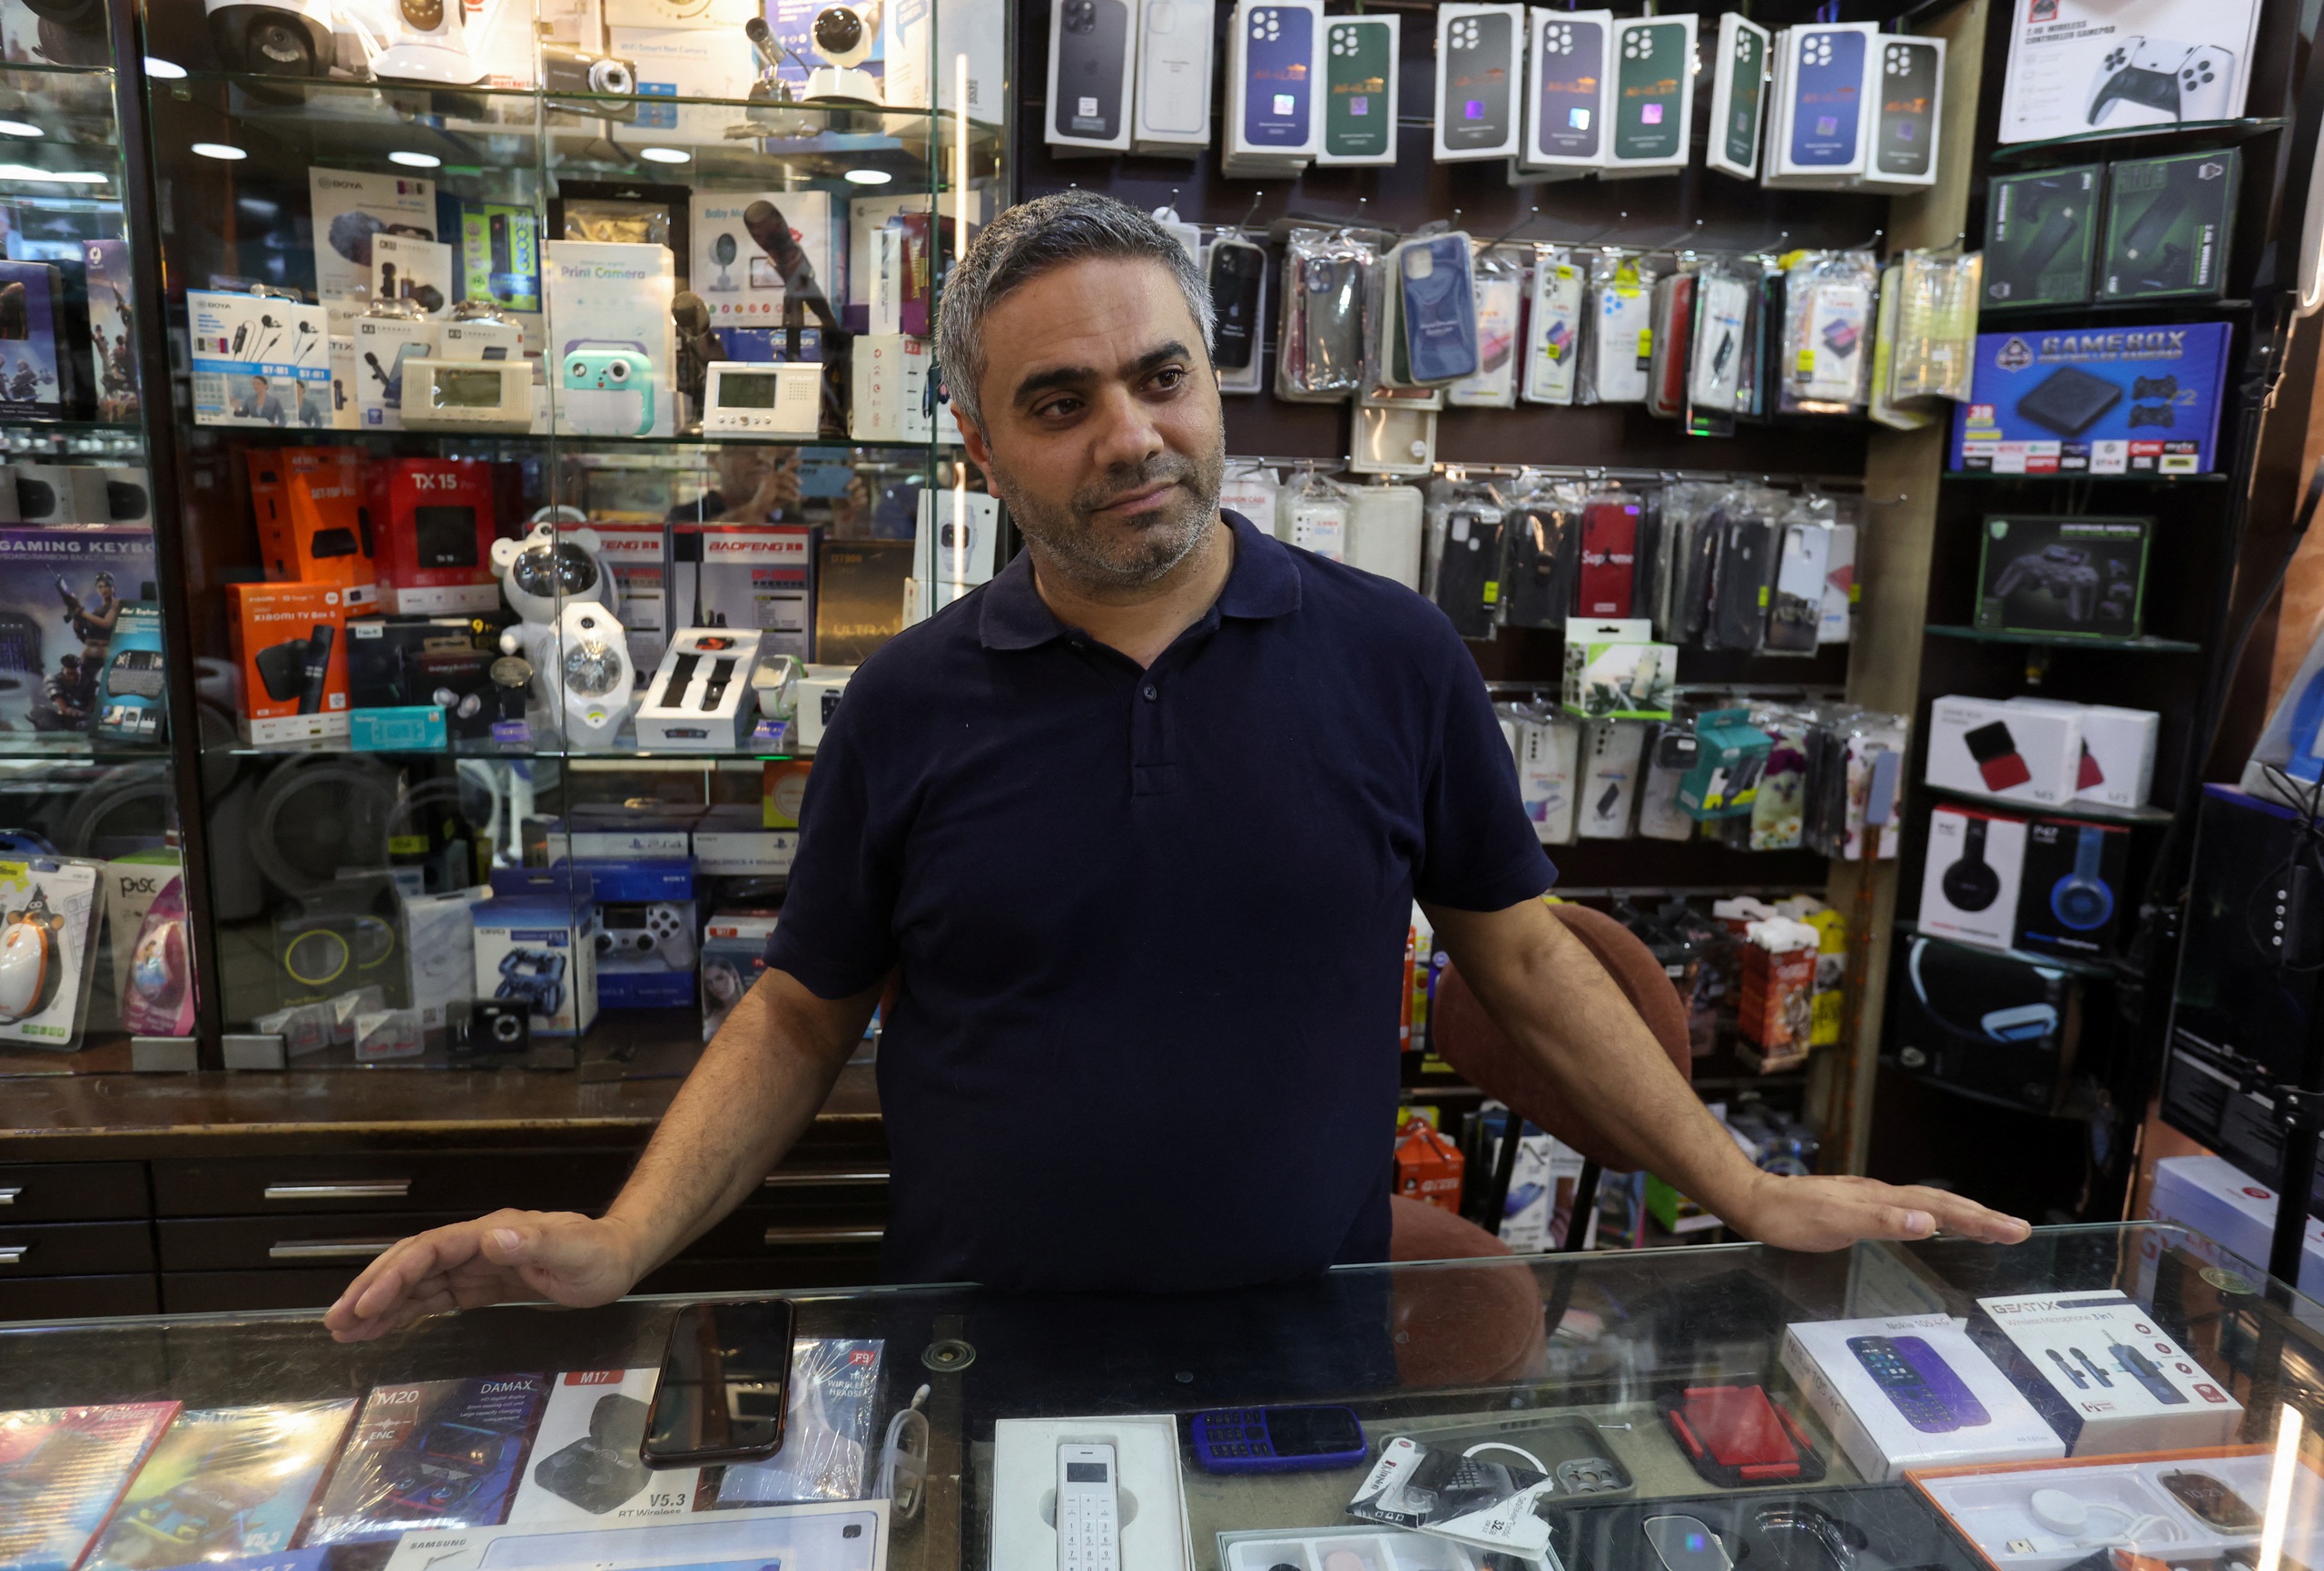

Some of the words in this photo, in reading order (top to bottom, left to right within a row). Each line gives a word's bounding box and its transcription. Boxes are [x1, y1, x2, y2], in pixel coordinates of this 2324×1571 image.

[560, 266, 591, 280] Print
[594, 267, 646, 280] Camera
[2042, 330, 2187, 353] GAMEBOX
[438, 472, 458, 488] 15
[0, 540, 82, 553] GAMING
[709, 541, 784, 551] BAOFENG
[298, 612, 310, 620] TV
[833, 623, 889, 636] ULTRA
[1886, 1321, 1915, 1330] Nokia
[1914, 1319, 1934, 1328] 105
[1933, 1318, 1951, 1327] 4G
[2004, 1316, 2043, 1327] Wireless
[2043, 1313, 2093, 1325] Microphone
[854, 1352, 869, 1363] F9
[579, 1371, 609, 1384] M17
[480, 1380, 533, 1395] DAMAX
[377, 1389, 419, 1406] M20
[100, 1408, 165, 1422] NEWEST
[369, 1430, 395, 1440] ENC
[650, 1493, 686, 1507] V5.3
[410, 1538, 467, 1550] SAMSUNG
